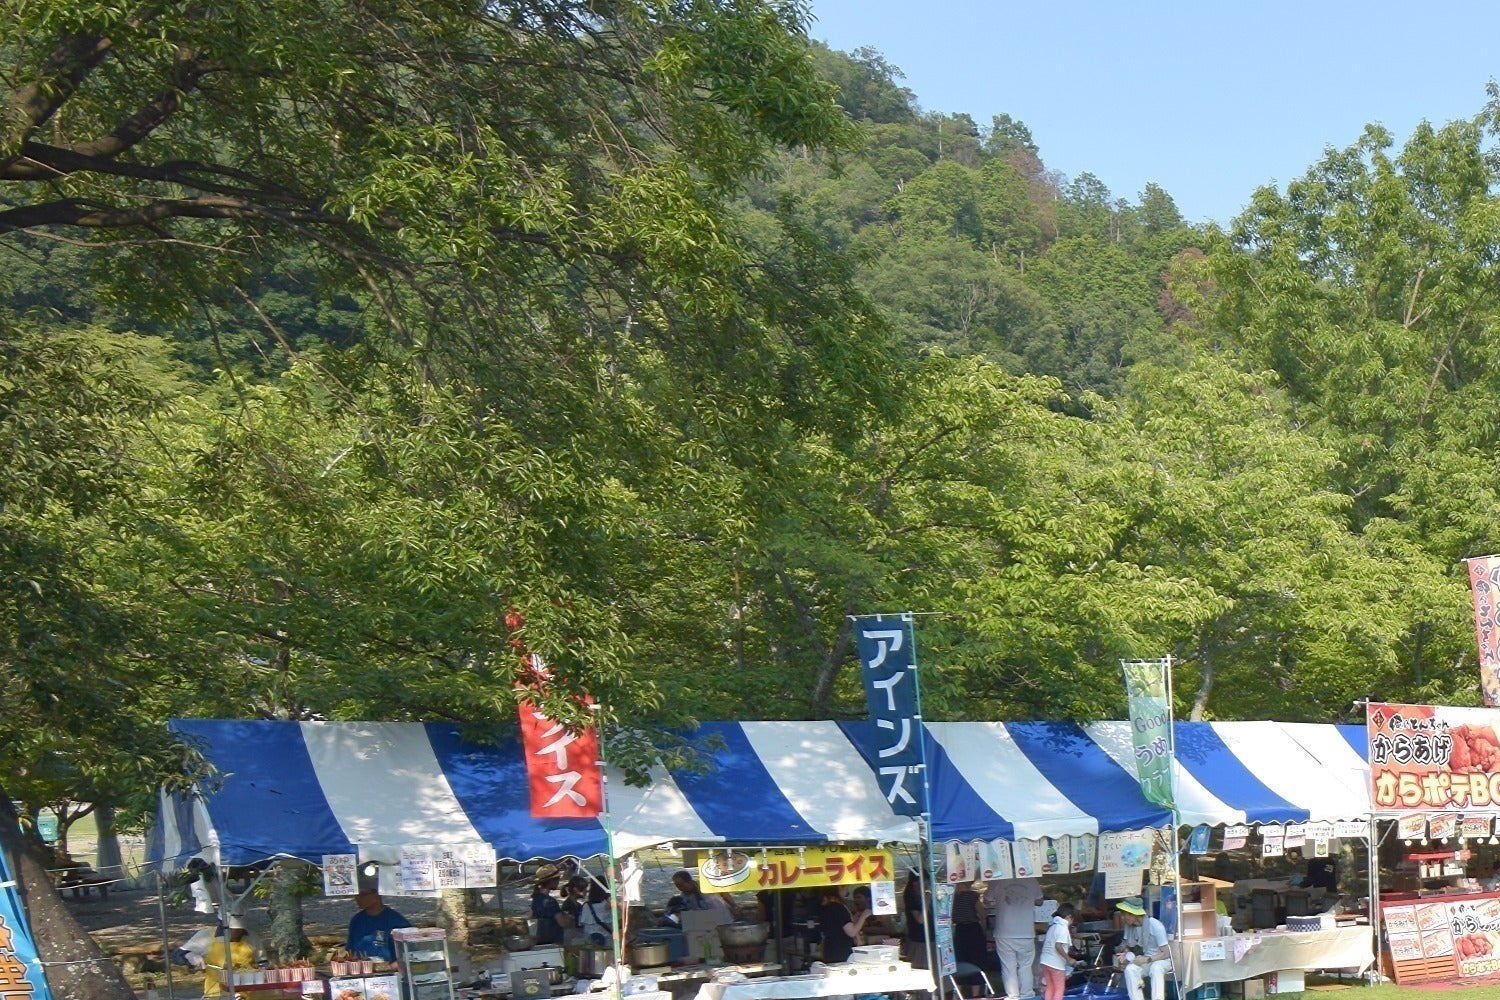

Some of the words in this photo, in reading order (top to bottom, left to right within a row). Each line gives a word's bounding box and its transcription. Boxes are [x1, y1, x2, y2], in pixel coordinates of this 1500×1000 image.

[862, 629, 919, 804] アインズ
[1134, 710, 1167, 733] Good
[1136, 737, 1168, 767] うめ
[1372, 734, 1452, 765] からあげ
[757, 854, 890, 886] カレーライス
